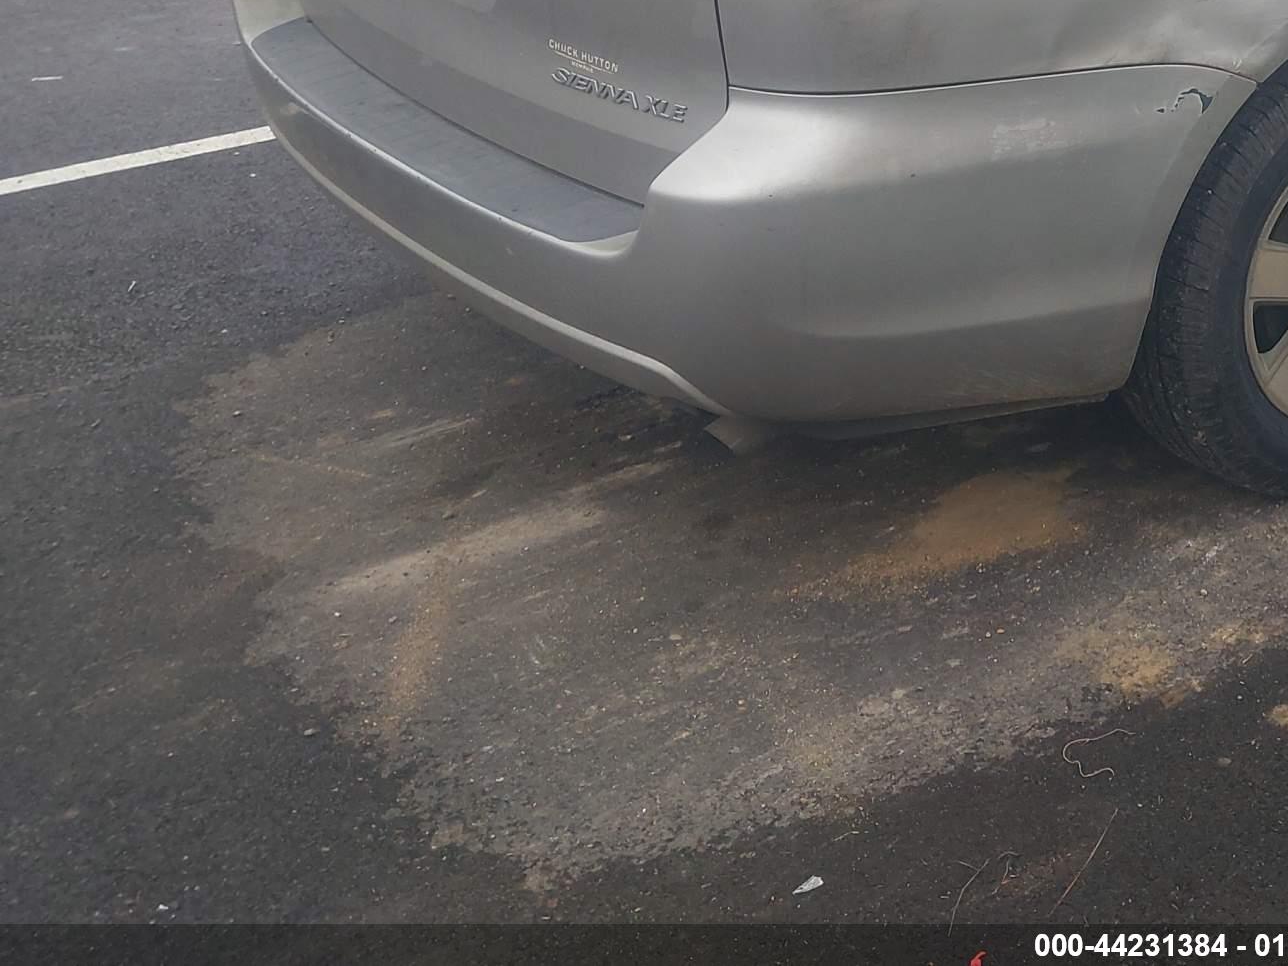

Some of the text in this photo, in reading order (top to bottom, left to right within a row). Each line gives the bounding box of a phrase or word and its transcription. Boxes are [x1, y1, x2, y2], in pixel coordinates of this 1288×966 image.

[548, 38, 619, 73] CHUCK HUTTON
[551, 67, 688, 123] SIENNA XLE
